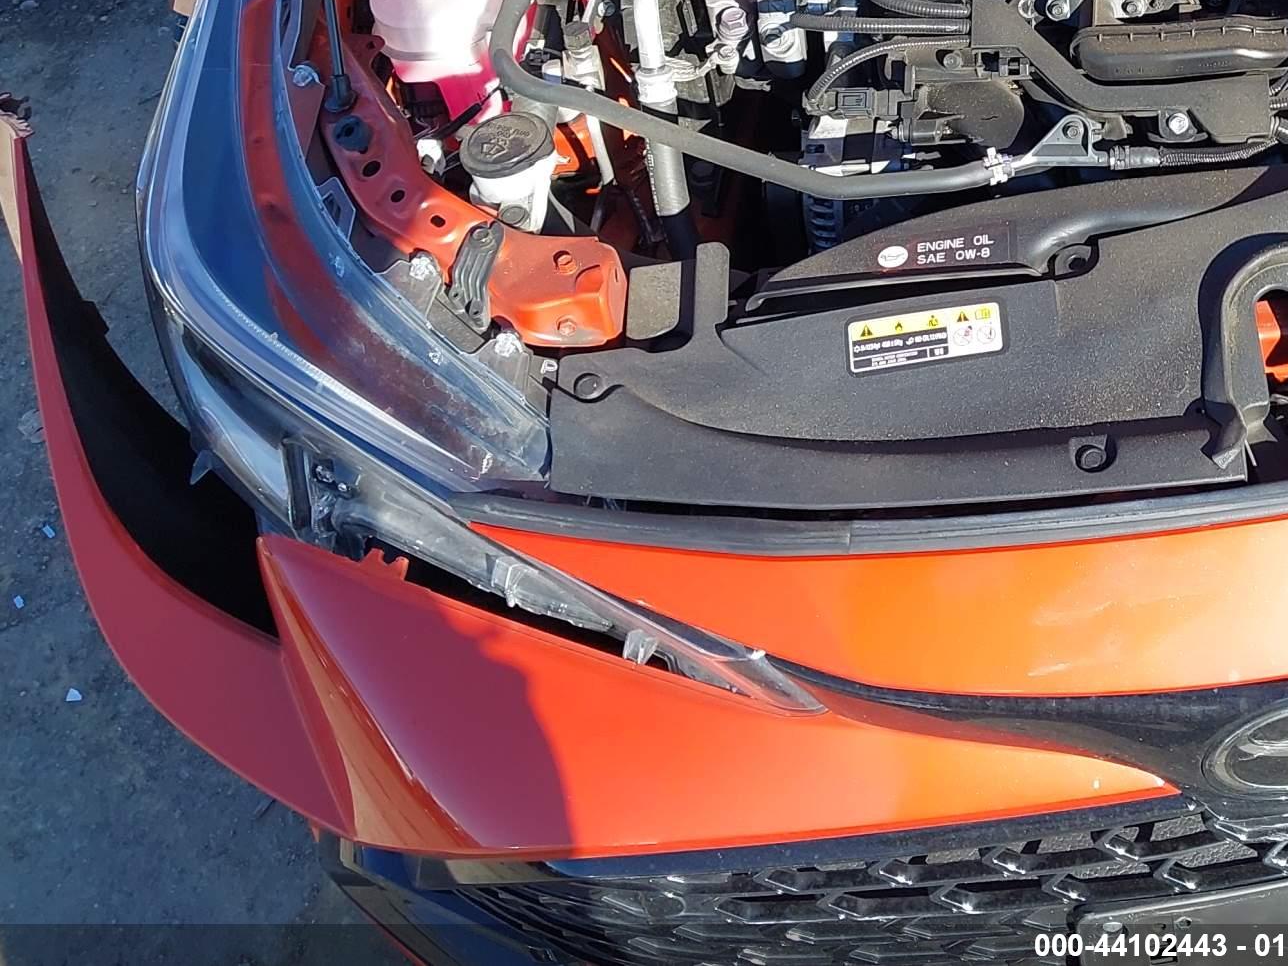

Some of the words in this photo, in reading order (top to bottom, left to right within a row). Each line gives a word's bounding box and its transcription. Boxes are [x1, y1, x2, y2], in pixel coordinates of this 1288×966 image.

[917, 237, 965, 253] ENGINE
[973, 234, 994, 246] OIL
[917, 252, 946, 265] SAE
[955, 247, 990, 261] 0W-8
